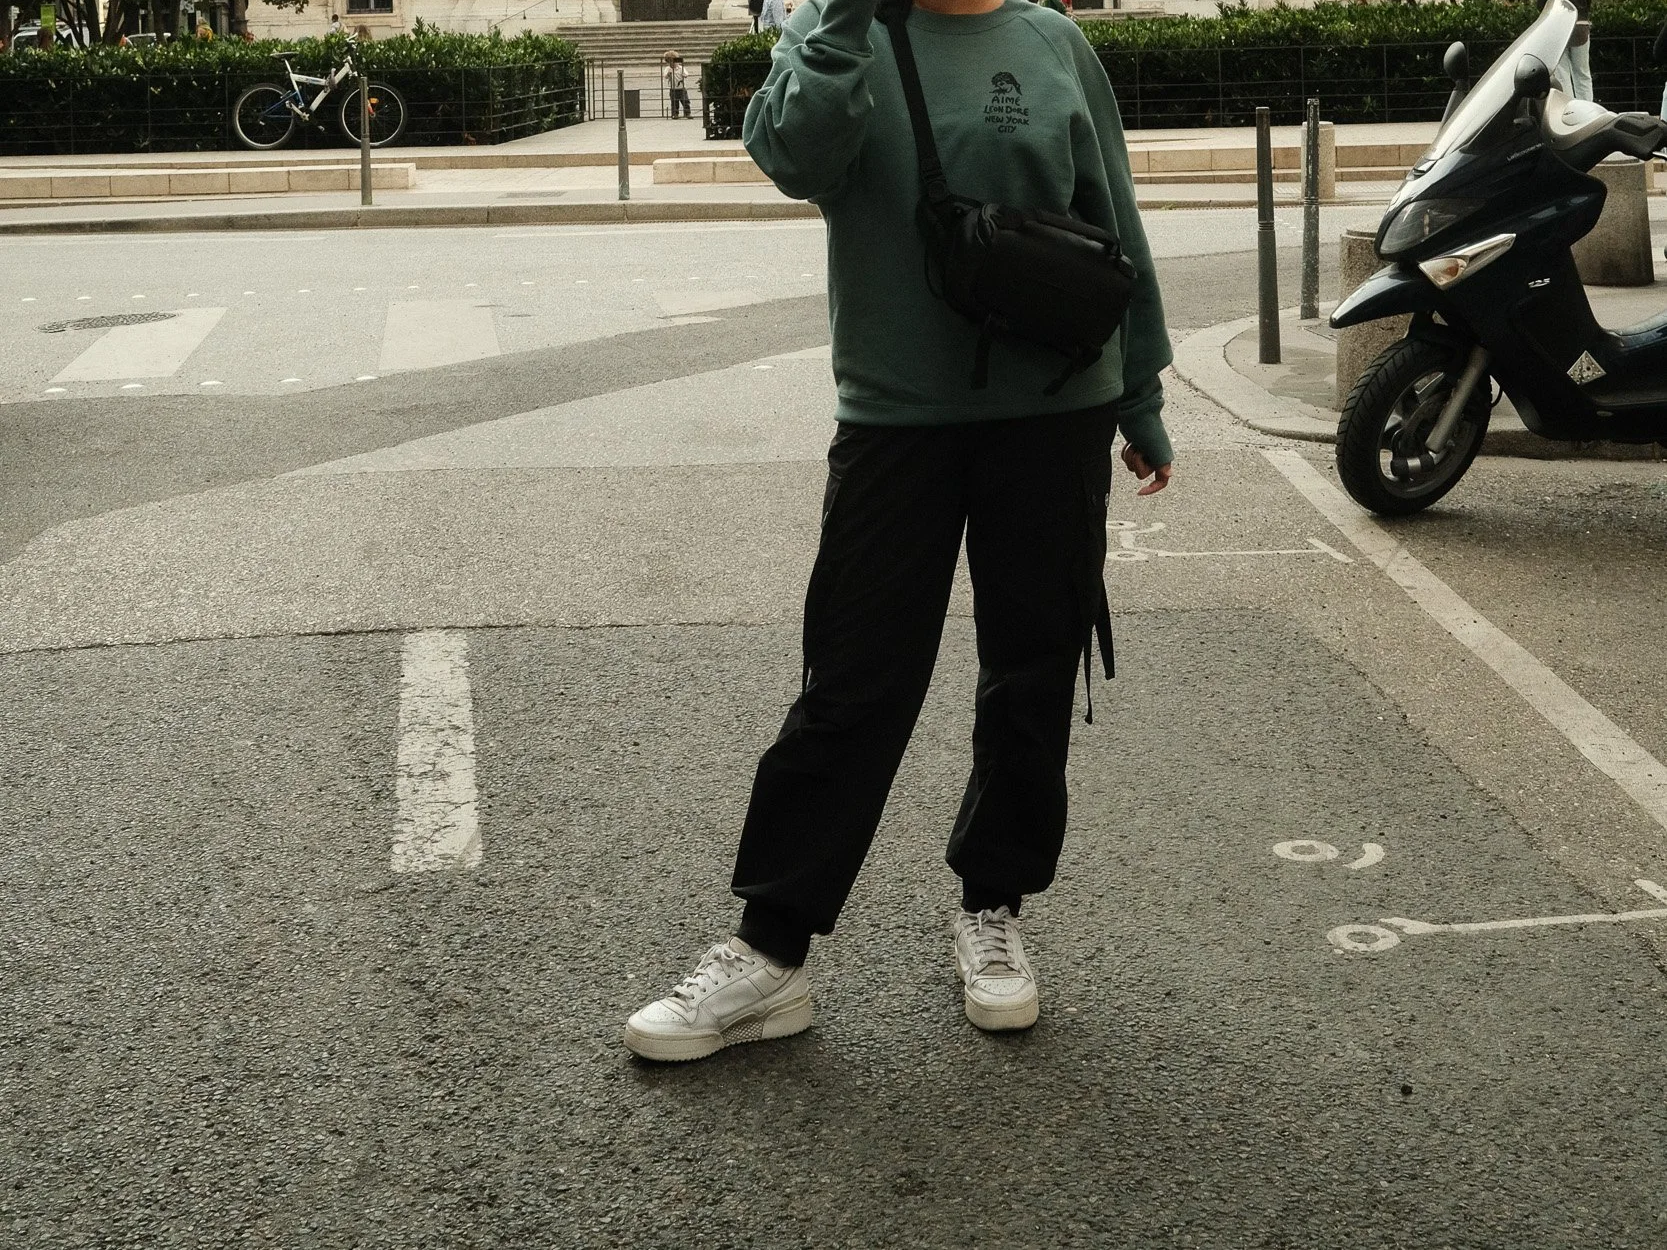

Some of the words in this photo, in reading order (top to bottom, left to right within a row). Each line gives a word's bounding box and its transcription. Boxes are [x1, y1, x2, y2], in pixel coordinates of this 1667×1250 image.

[983, 104, 1004, 114] LEON
[1005, 105, 1029, 116] DORE
[984, 115, 1004, 124] NEW
[1005, 115, 1030, 126] YORK
[997, 124, 1017, 134] CITY
